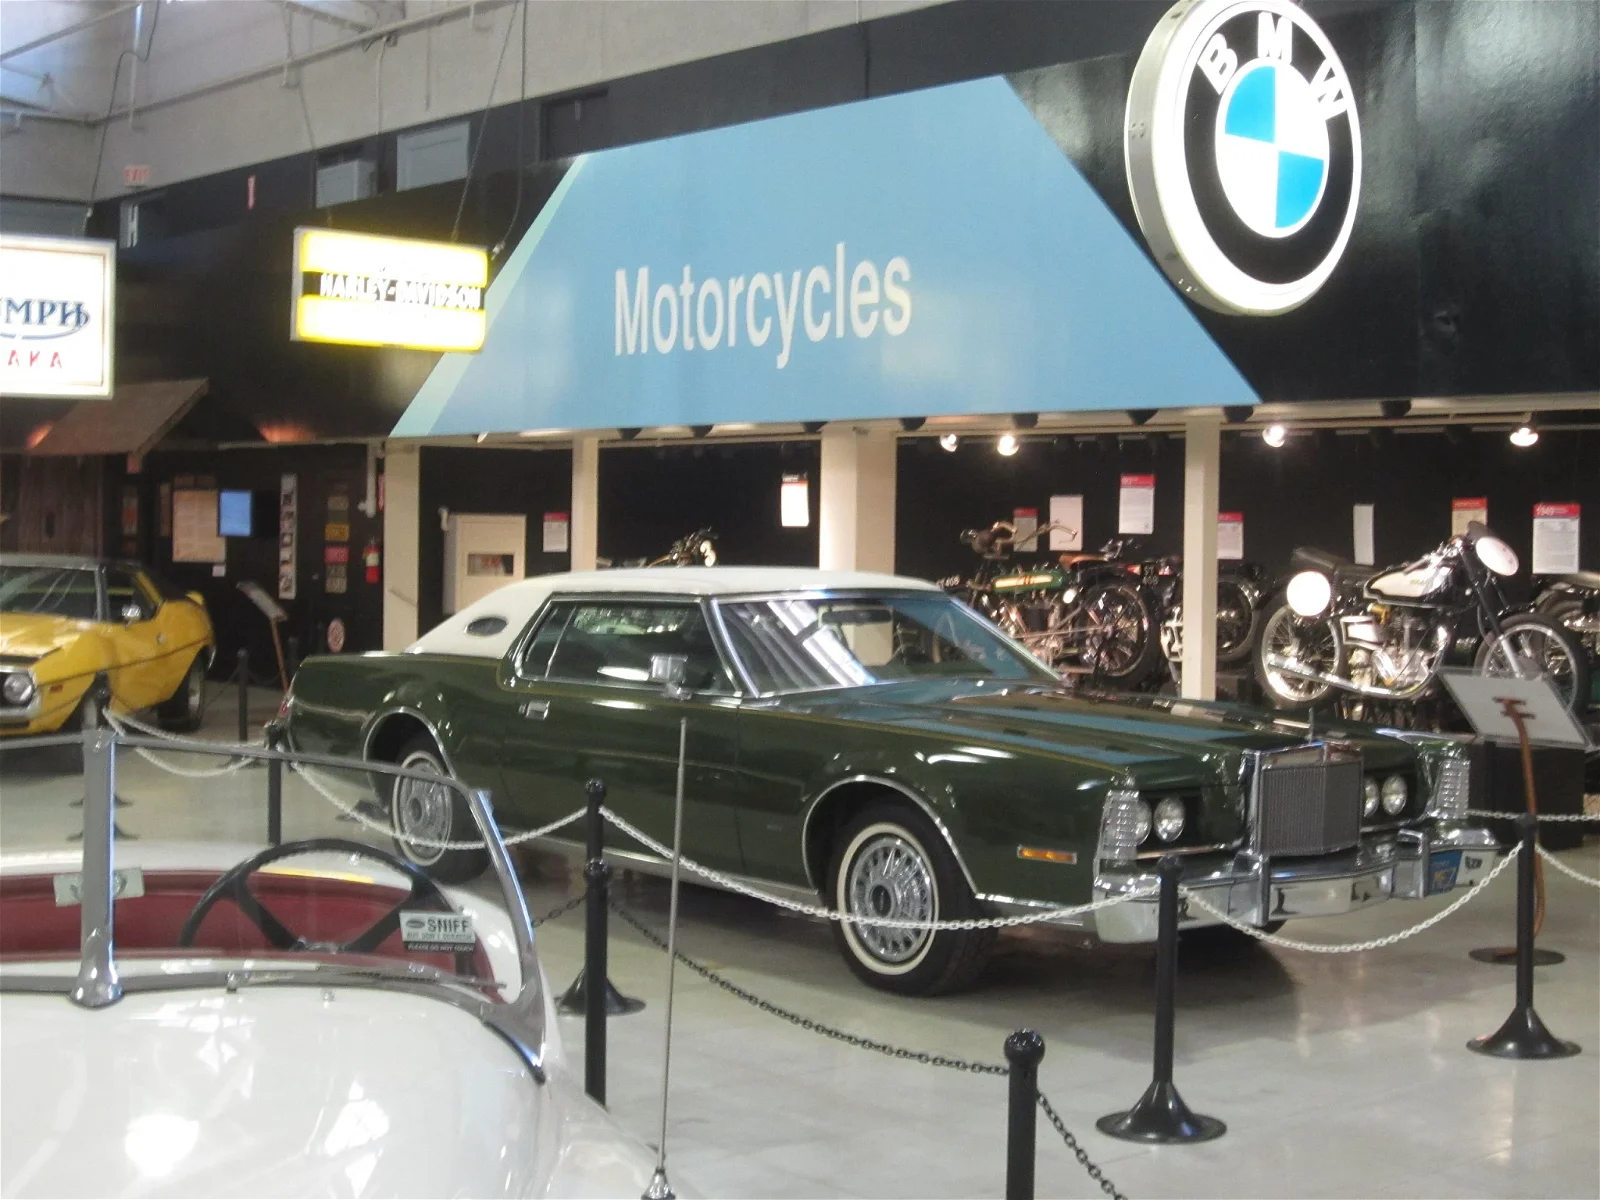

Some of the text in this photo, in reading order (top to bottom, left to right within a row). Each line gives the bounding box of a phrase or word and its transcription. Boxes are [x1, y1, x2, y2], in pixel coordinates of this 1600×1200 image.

[1197, 11, 1348, 121] BMW
[320, 273, 481, 310] HARLEY-DAVIDSON
[614, 241, 912, 370] Motorcycles
[0, 297, 90, 329] MPH
[427, 919, 469, 933] SNIFF
